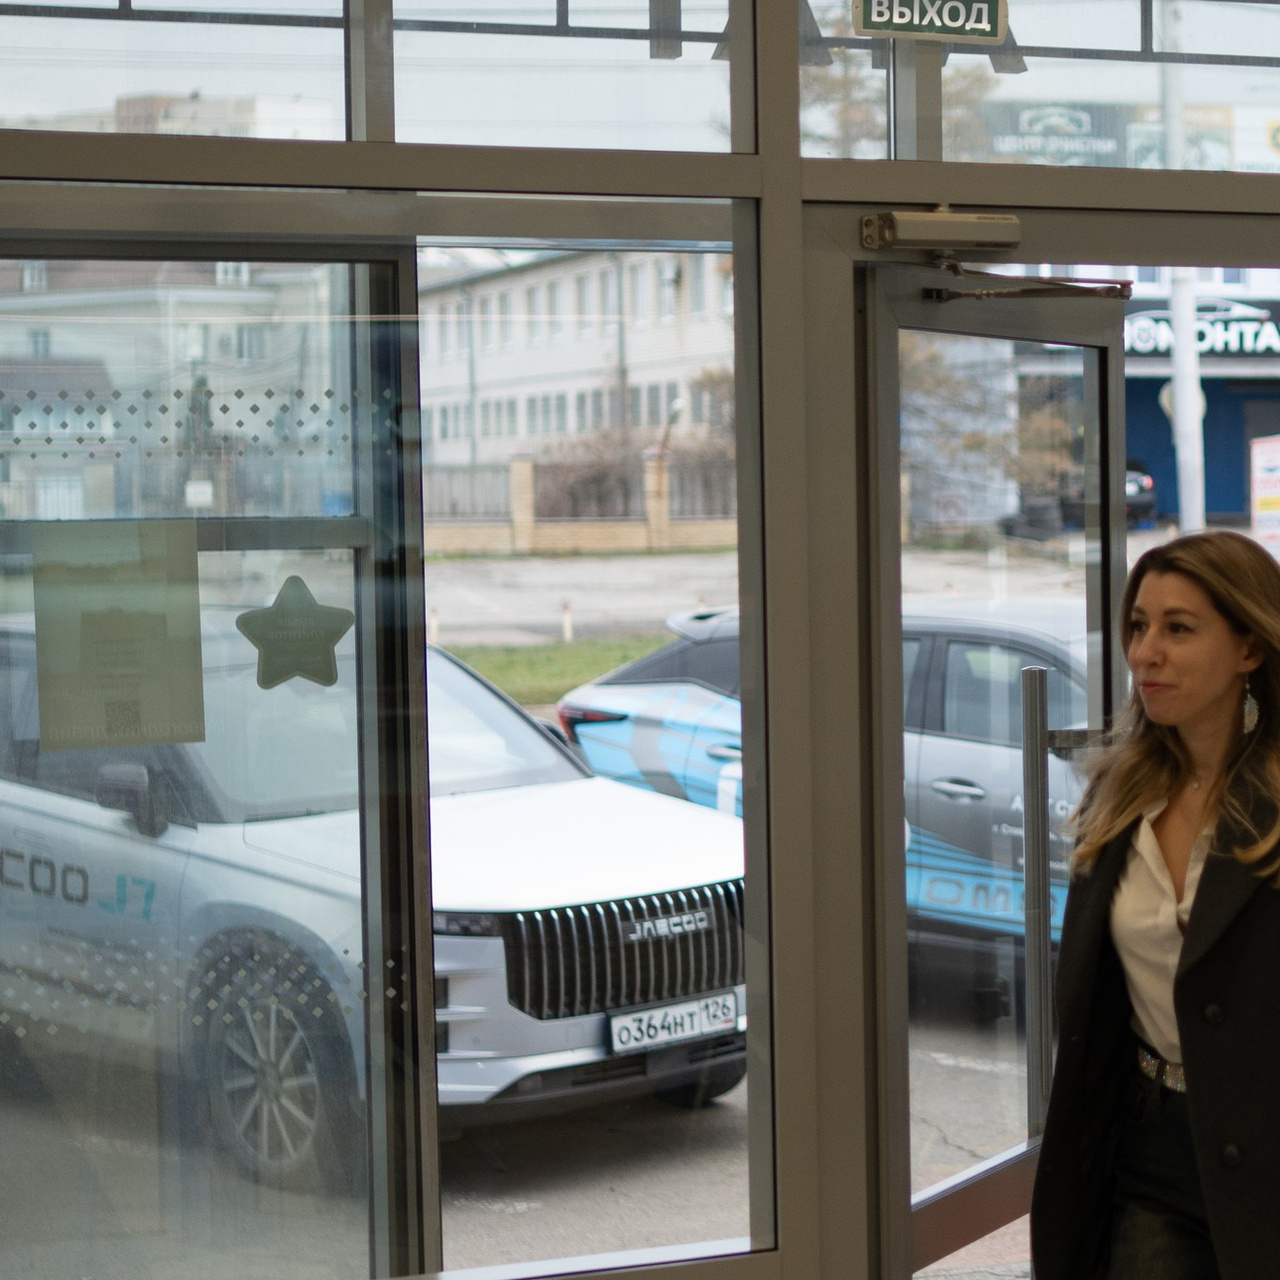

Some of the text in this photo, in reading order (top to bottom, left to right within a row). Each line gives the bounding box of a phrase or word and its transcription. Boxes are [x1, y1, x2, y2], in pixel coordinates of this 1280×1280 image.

[98, 873, 156, 923] J7
[926, 877, 1058, 918] OM
[628, 911, 708, 941] JAECOO
[617, 997, 731, 1046] О364НТ 126
